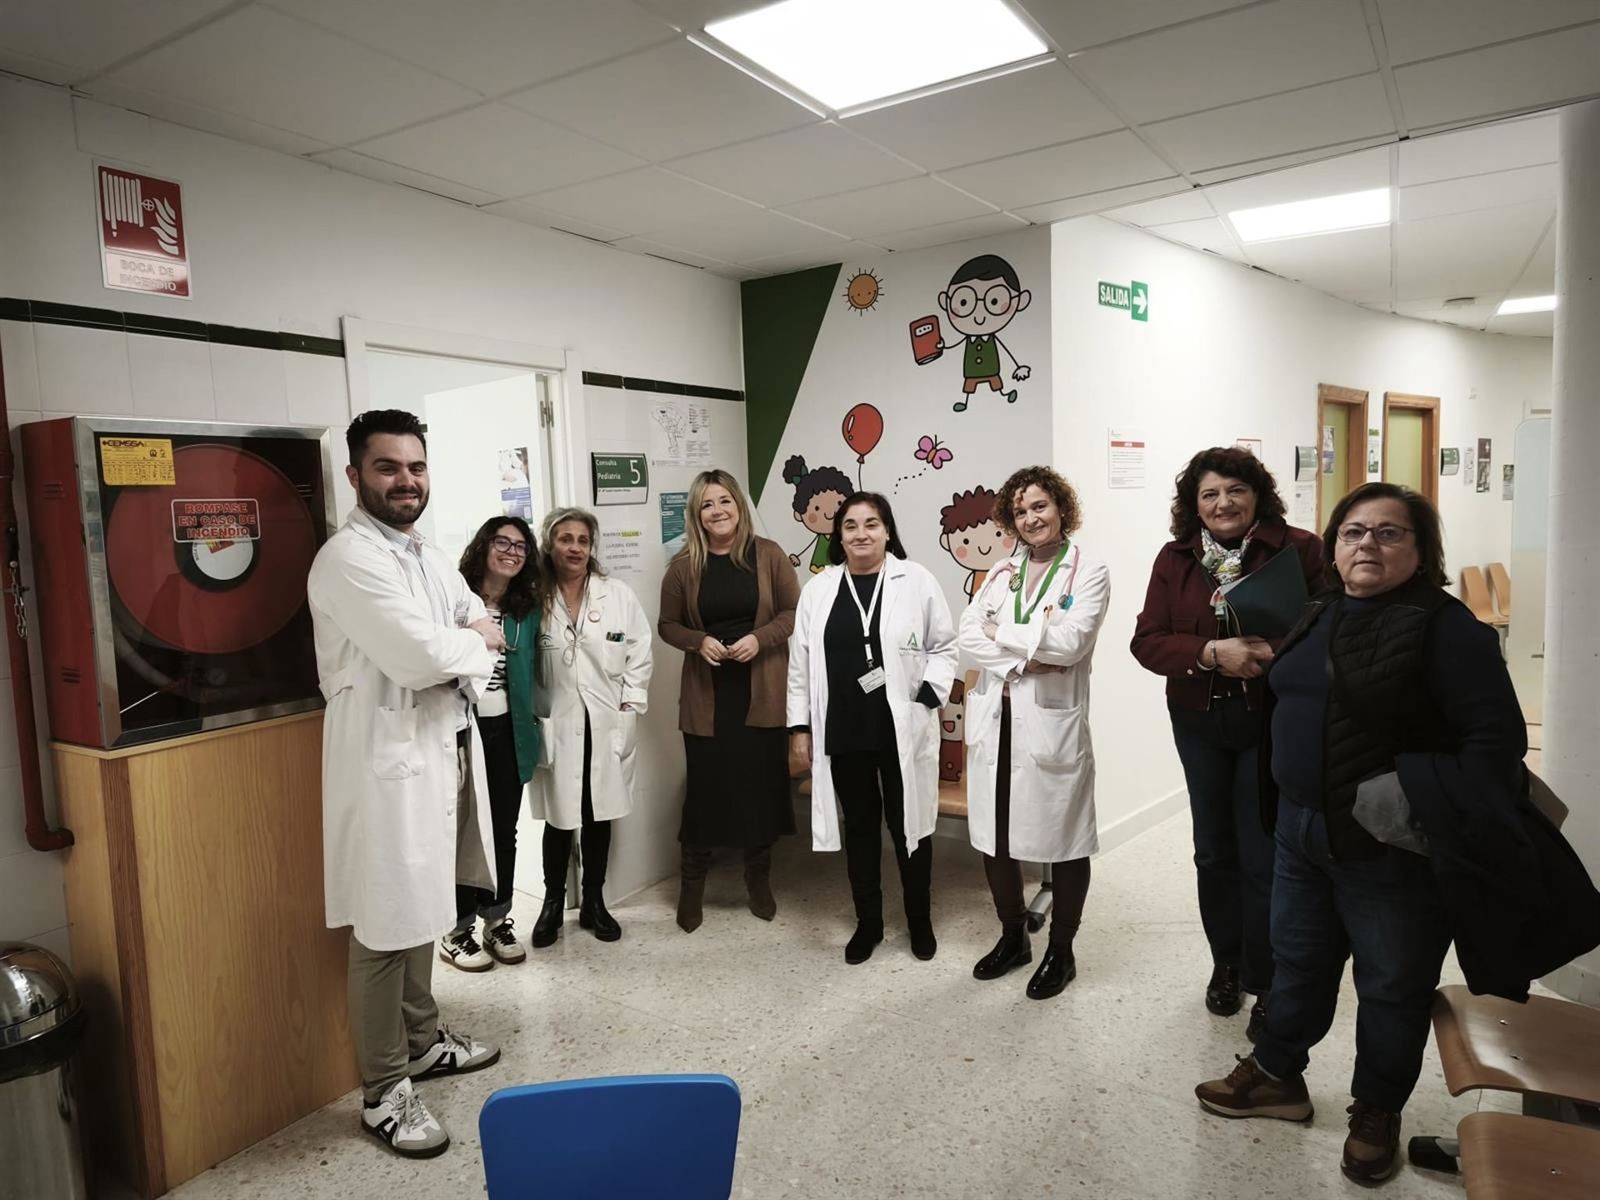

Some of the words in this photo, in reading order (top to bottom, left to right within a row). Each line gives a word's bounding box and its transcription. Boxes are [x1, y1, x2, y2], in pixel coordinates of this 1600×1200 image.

[120, 259, 155, 275] BOCA
[158, 265, 174, 277] DE
[1100, 284, 1129, 307] SALIDA
[630, 459, 641, 485] 5
[185, 503, 248, 514] ROMPASE
[178, 515, 197, 526] EN
[199, 515, 237, 526] CASO
[239, 514, 257, 525] DE
[187, 527, 249, 539] INCENDIO
